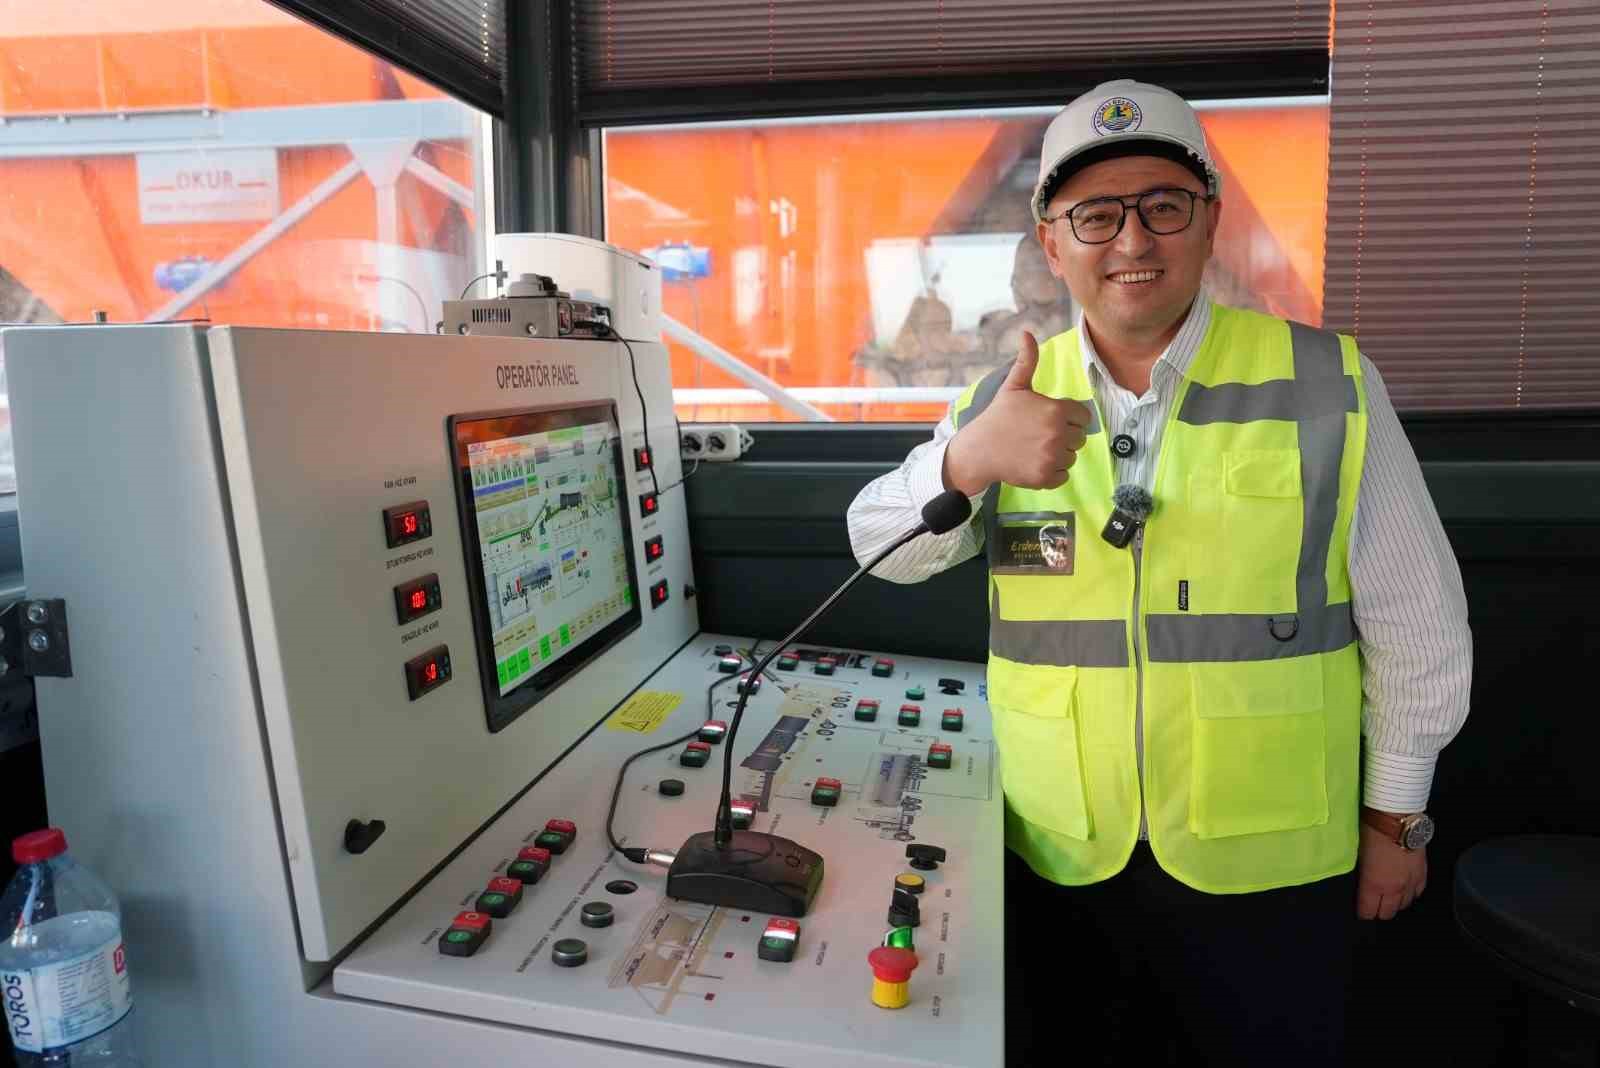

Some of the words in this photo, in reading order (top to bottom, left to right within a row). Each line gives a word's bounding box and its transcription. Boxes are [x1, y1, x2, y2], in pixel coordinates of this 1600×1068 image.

[176, 169, 236, 191] OKUR
[496, 360, 551, 389] OPERATÖR
[551, 364, 579, 388] PANEL
